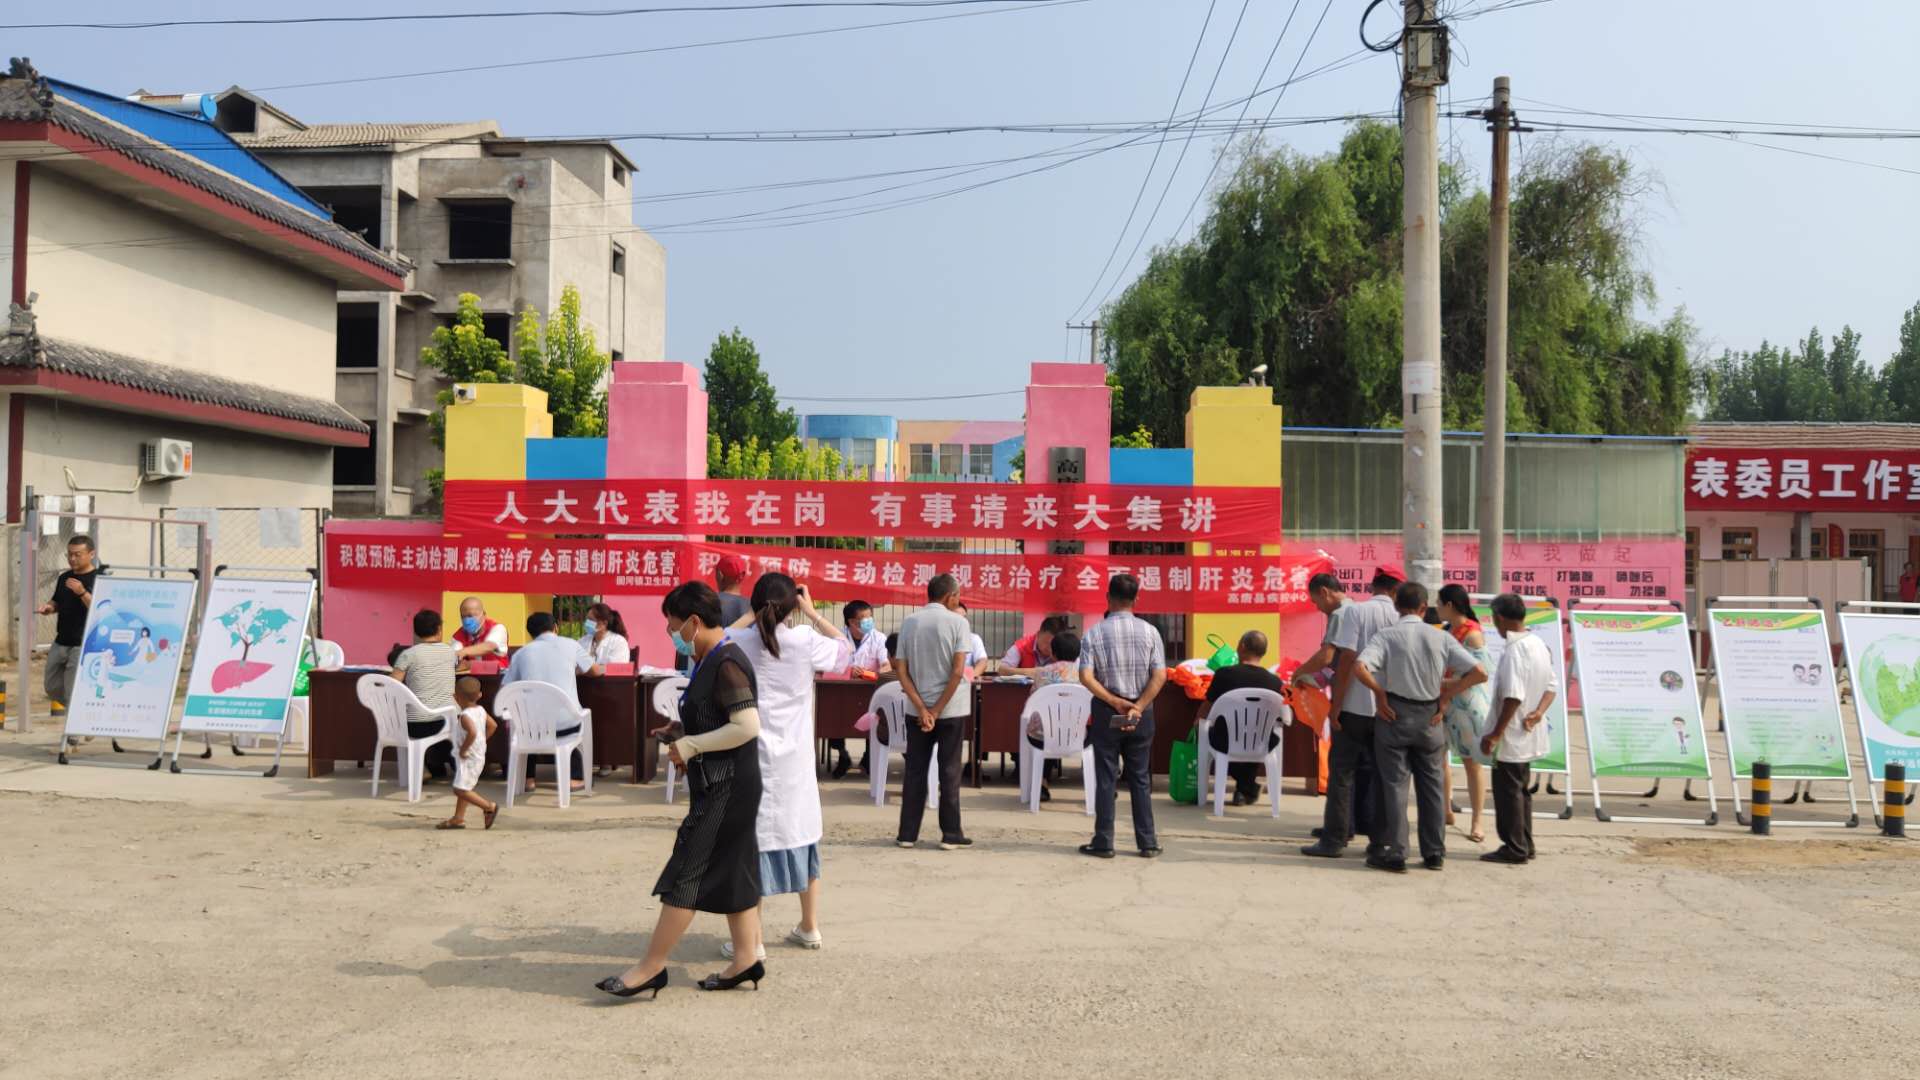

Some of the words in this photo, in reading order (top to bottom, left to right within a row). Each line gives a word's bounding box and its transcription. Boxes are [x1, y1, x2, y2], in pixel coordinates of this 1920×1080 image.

[494, 489, 825, 527] 人大代表我在岗
[870, 492, 1216, 532] 有事请来大集讲
[824, 559, 936, 586] 主动检测
[950, 564, 1063, 590] 规范治疗
[1077, 564, 1310, 592] 全遏制肝炎危害
